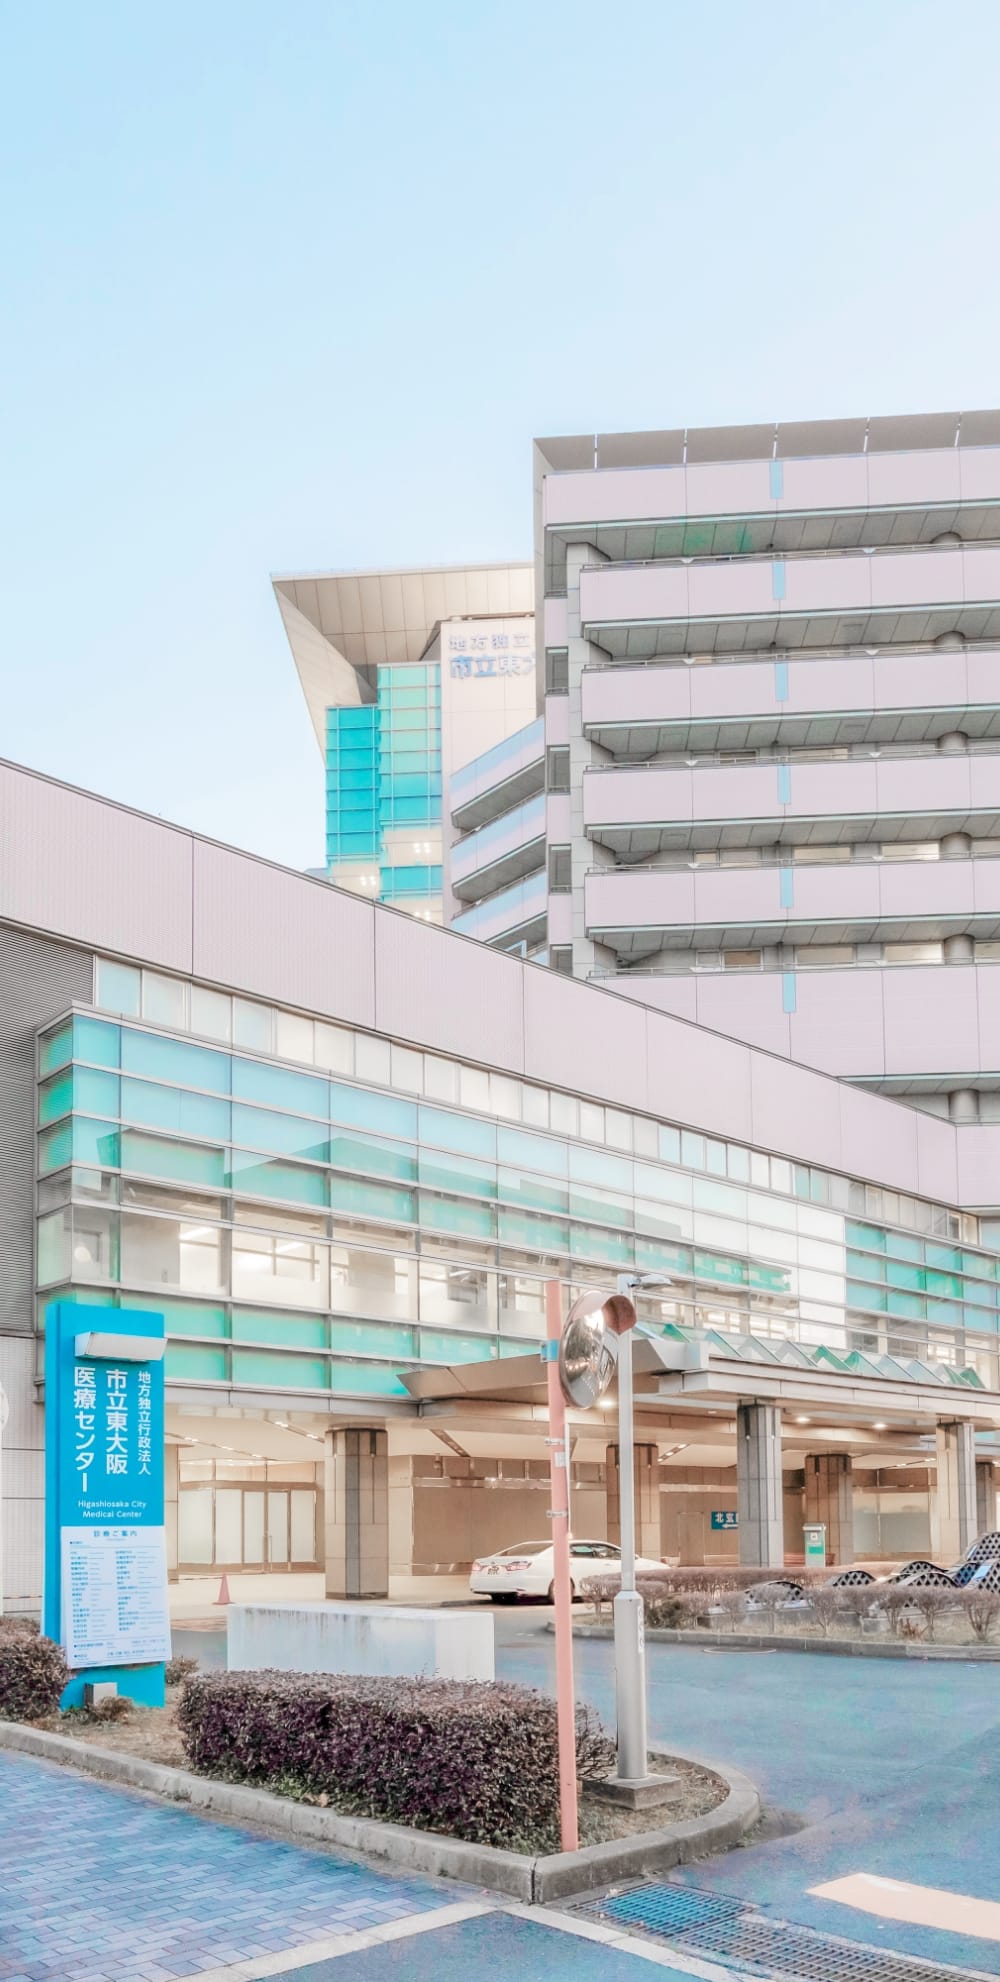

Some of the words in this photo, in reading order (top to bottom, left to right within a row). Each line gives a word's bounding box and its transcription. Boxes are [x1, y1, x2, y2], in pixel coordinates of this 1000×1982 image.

[74, 1366, 96, 1493] 医療センター
[106, 1369, 128, 1475] 市立東大阪
[138, 1371, 151, 1476] 地方独立行政法人
[78, 1500, 129, 1509] Higashiosaka
[131, 1500, 147, 1509] City
[82, 1510, 114, 1518] Medical
[116, 1510, 142, 1518] Center
